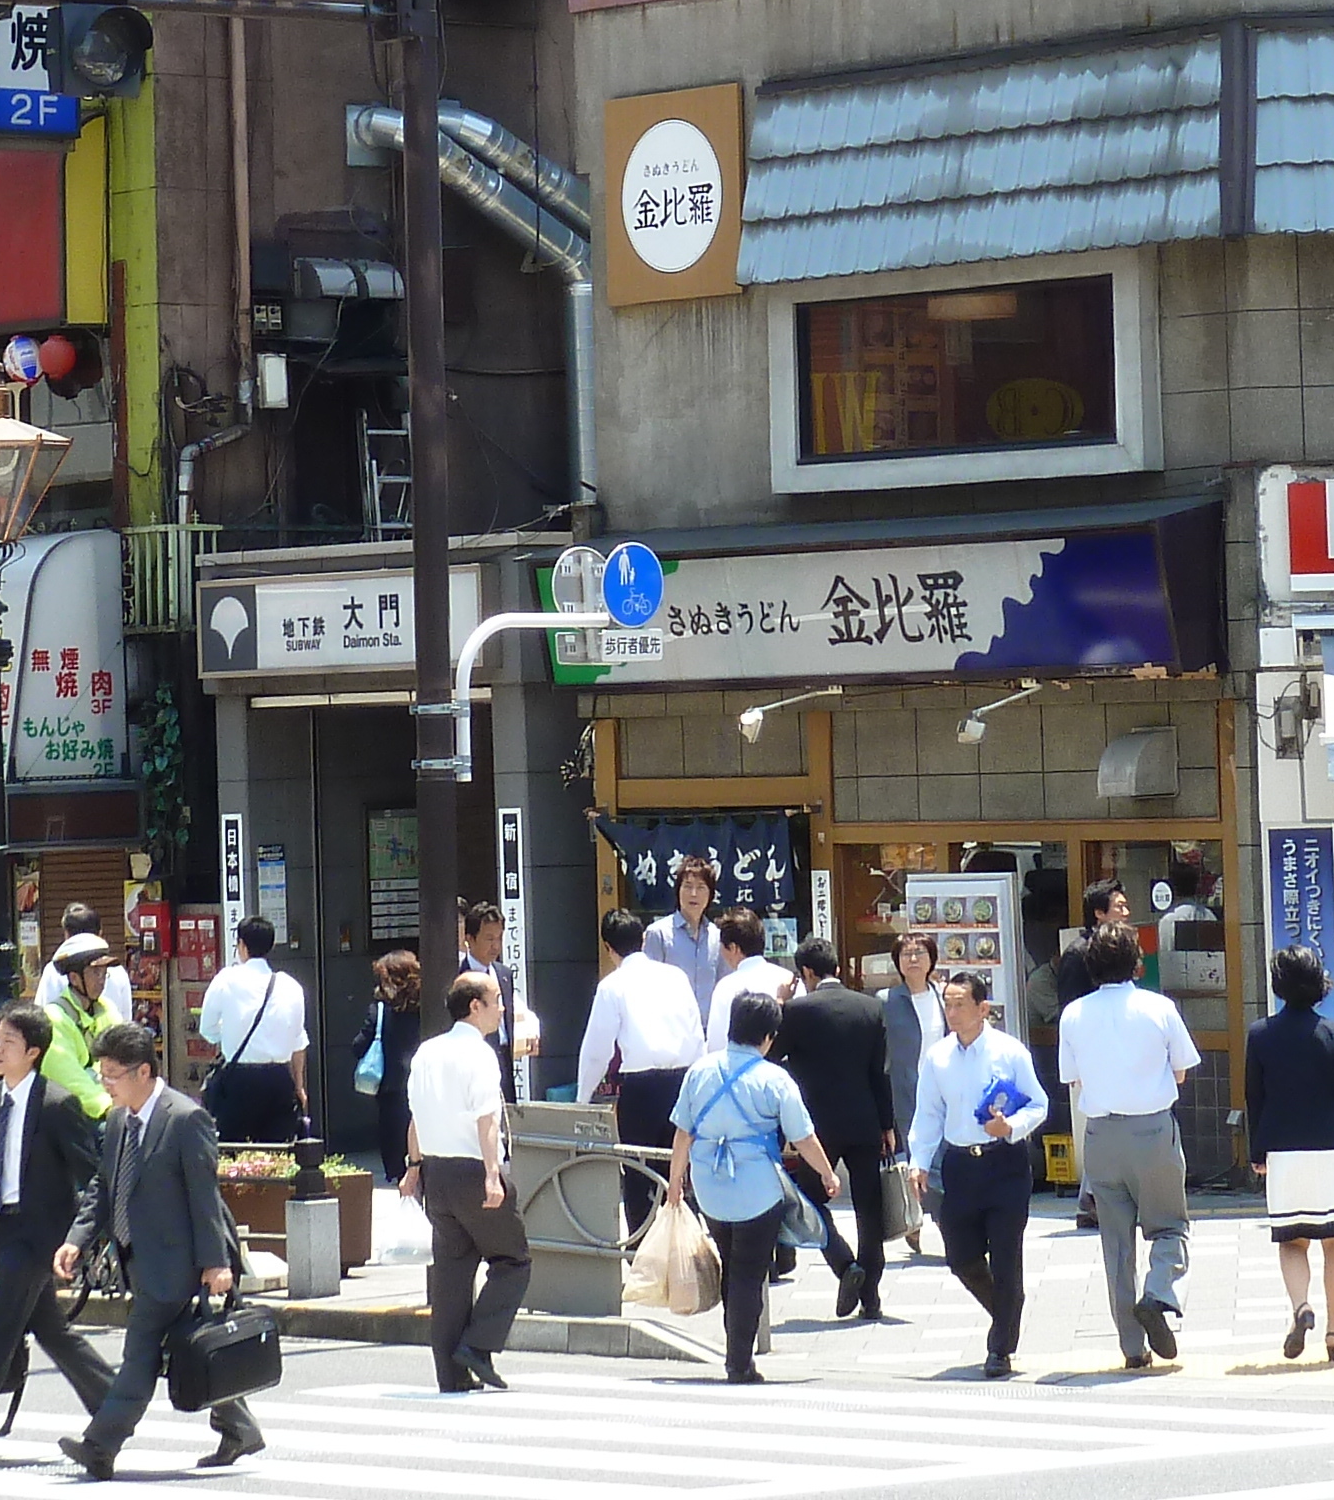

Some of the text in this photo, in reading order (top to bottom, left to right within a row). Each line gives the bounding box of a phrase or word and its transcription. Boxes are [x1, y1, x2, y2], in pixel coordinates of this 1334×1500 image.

[10, 92, 58, 128] 2F
[643, 158, 699, 178] さぬきうどん
[632, 182, 714, 231] 金比羅
[282, 593, 400, 638] 地下鉄 大門
[667, 569, 972, 647] さぬきうどん 金比羅
[285, 631, 403, 652] SUBWAY Daimon Sta.
[605, 635, 661, 656] 歩行者優先
[31, 647, 80, 672] 無煙
[55, 669, 113, 699] 焼肉
[90, 699, 113, 715] 3F
[22, 716, 86, 738] もんじゃ
[44, 738, 114, 761] お好み焼
[226, 828, 239, 893] 日本橋
[504, 821, 518, 891] 新宿
